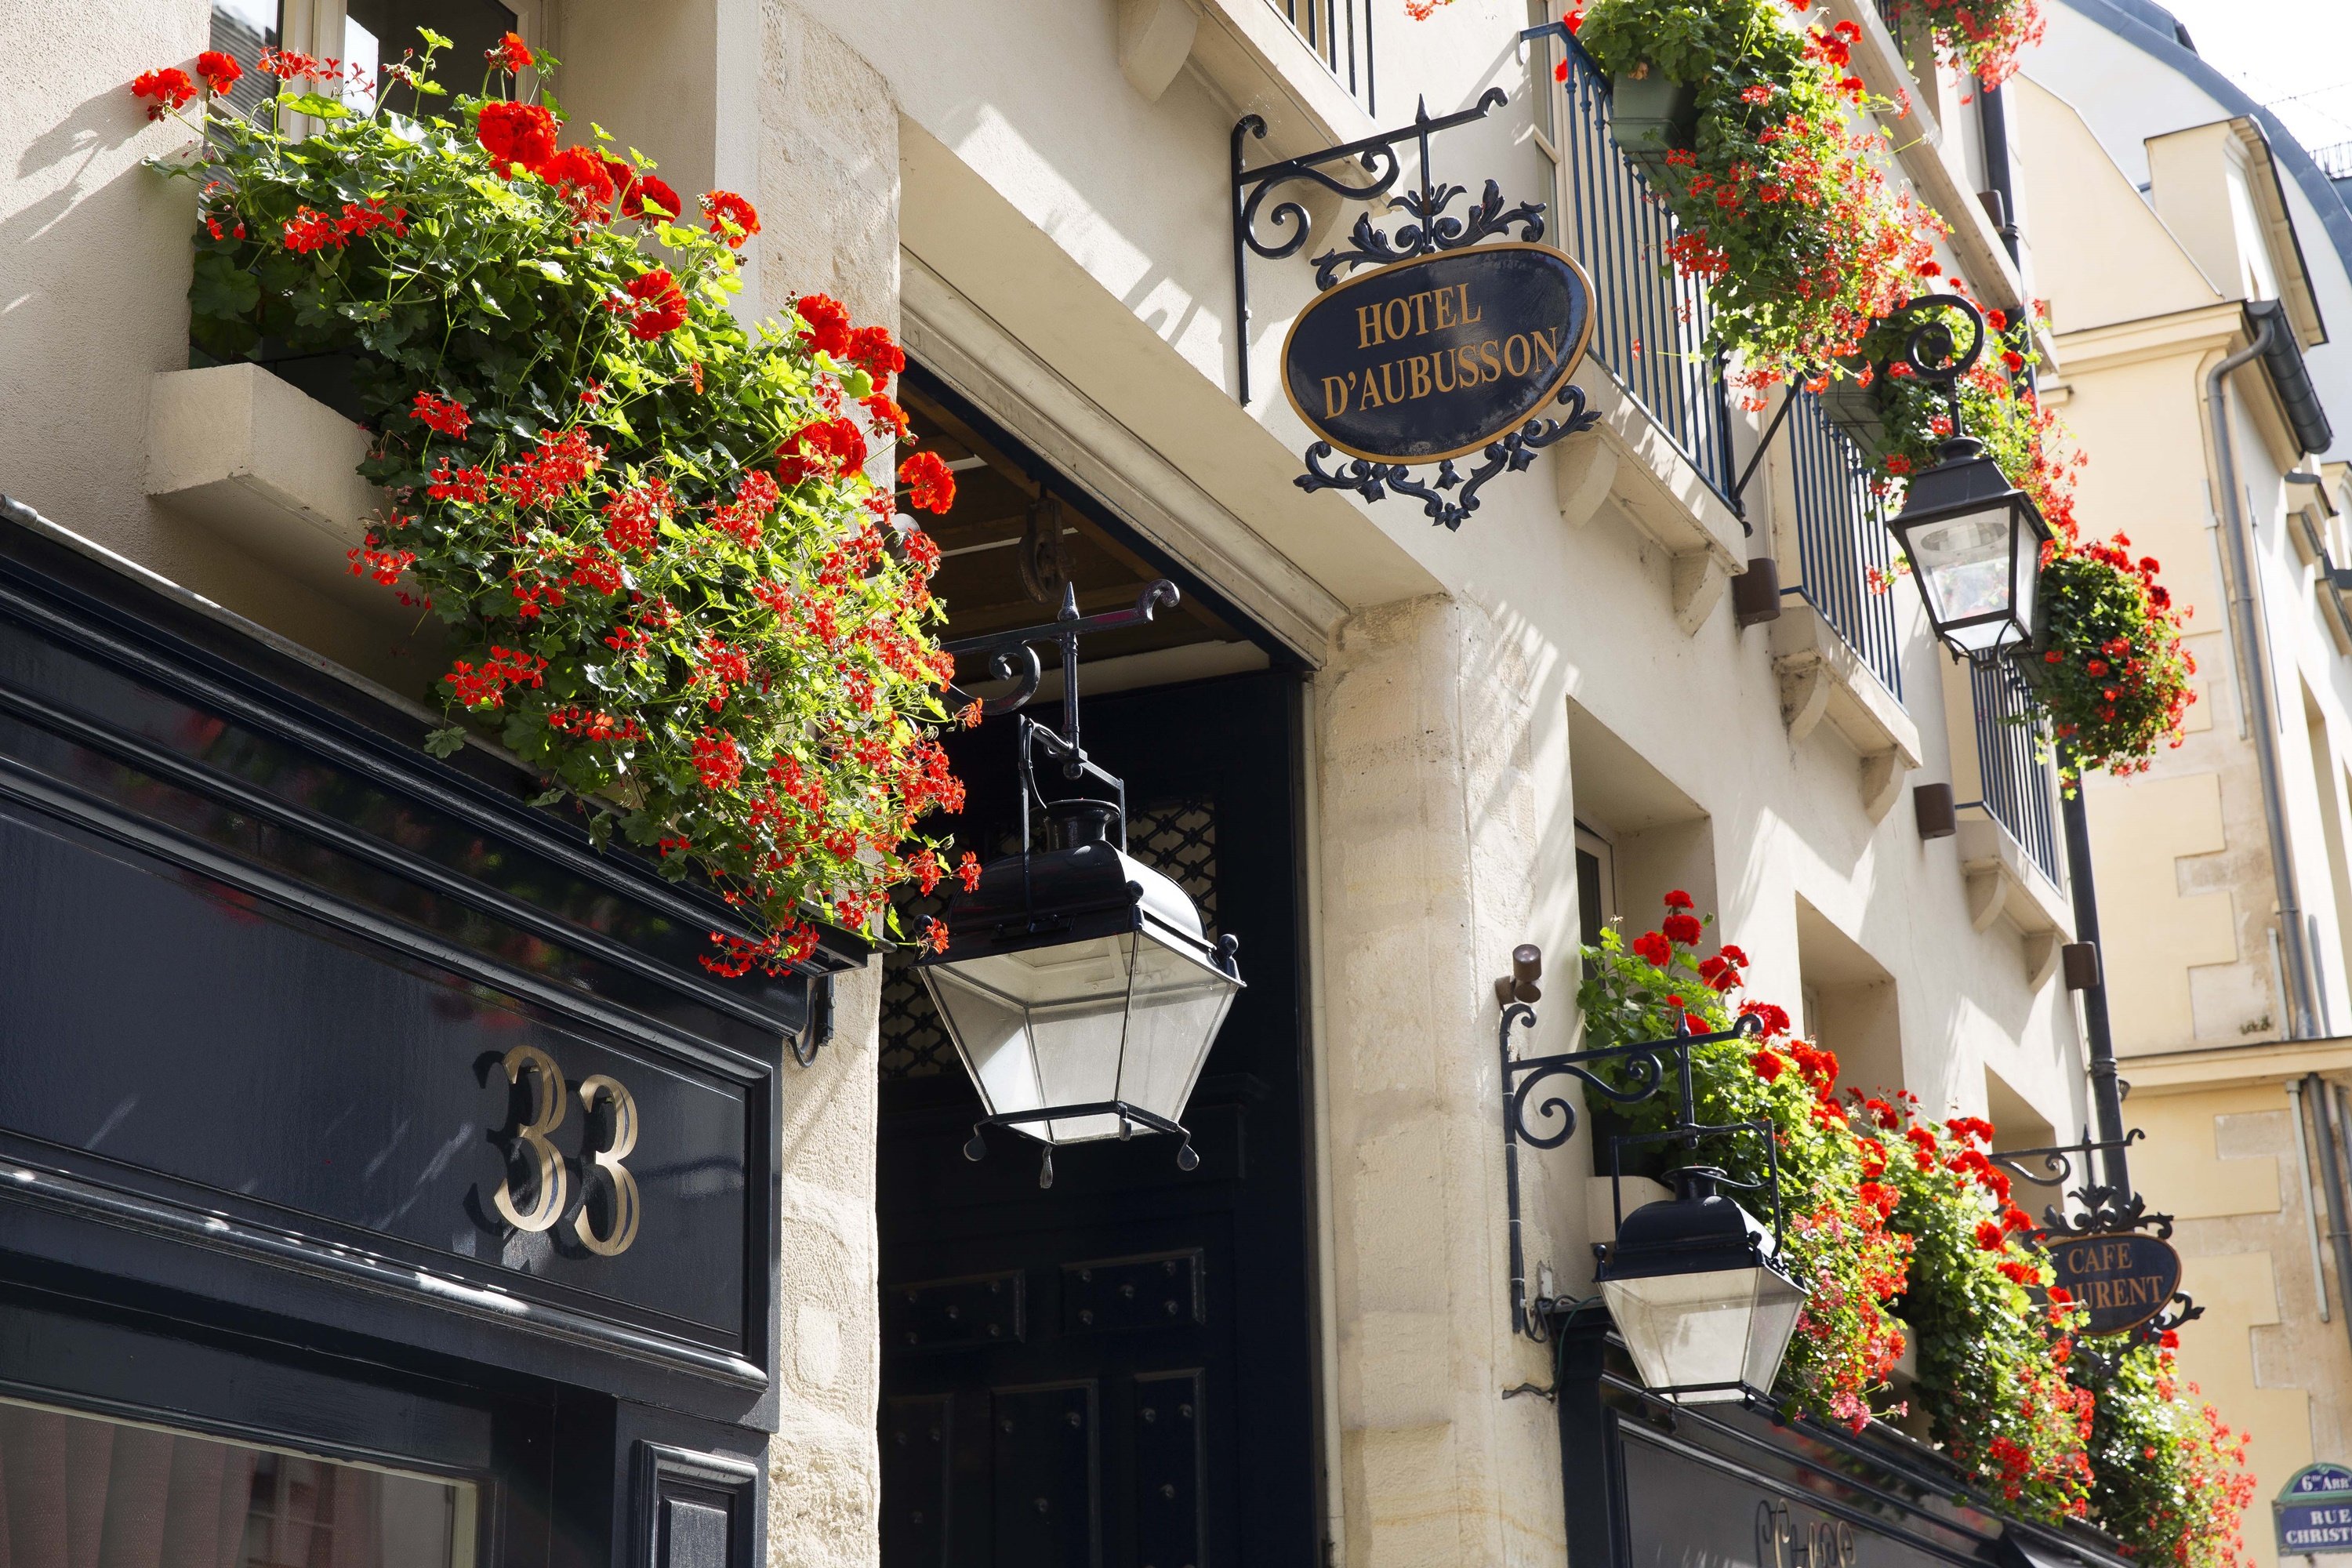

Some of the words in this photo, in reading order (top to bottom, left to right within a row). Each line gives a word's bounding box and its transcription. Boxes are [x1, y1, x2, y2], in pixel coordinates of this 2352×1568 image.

[1356, 283, 1482, 349] HOTEL
[1321, 327, 1560, 420] D'AUBUSSON
[493, 1045, 640, 1256] 33
[2067, 1243, 2133, 1275] CAFE
[2285, 1526, 2352, 1544] CHRIST
[2310, 1508, 2351, 1526] RUE
